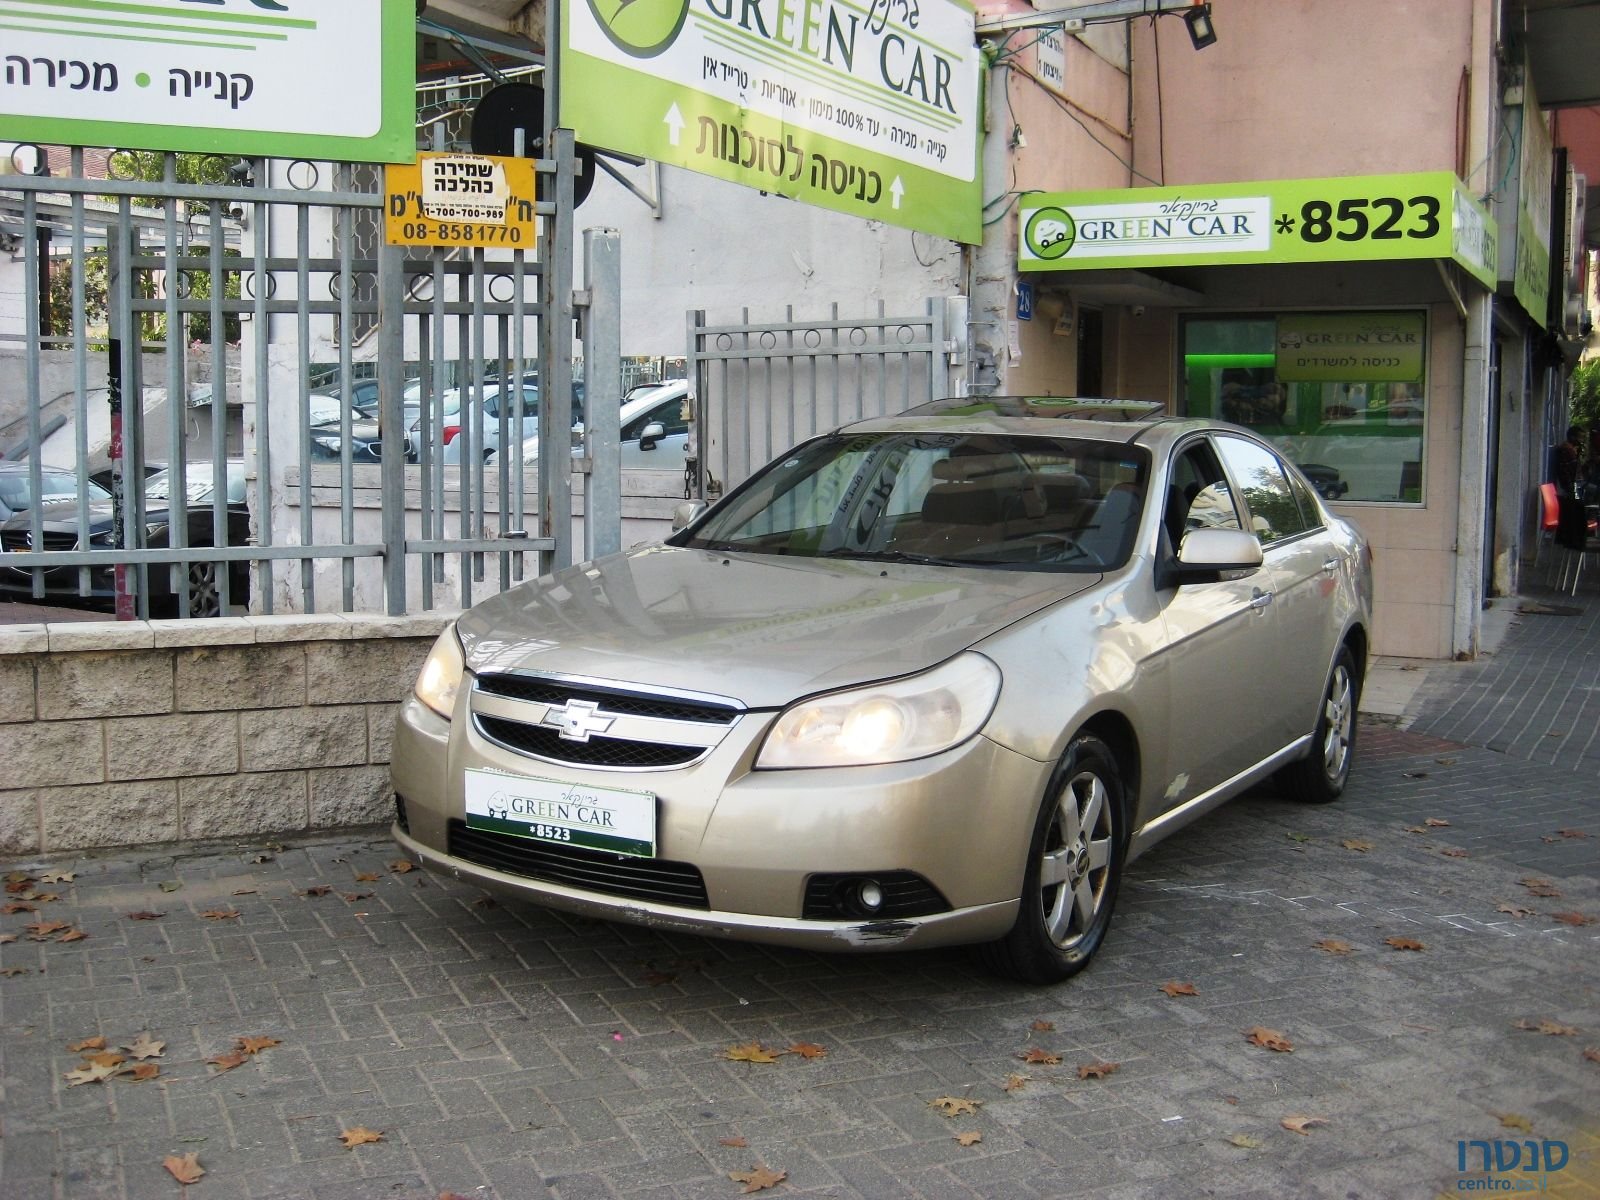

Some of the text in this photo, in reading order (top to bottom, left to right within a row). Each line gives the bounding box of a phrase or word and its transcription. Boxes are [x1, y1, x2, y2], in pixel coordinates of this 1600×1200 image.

[5, 55, 254, 110] קנייה מכירה
[880, 33, 957, 115] CAR
[702, 54, 948, 163] קנייה מכירה עד 100% מימון אחריות טרייד אין
[434, 162, 493, 178] שמירה
[695, 115, 882, 204] כניסה לסוכנות
[434, 177, 493, 194] כהלכה
[425, 207, 504, 219] 1-700-700-989
[403, 222, 521, 243] 08-8581770
[1080, 215, 1253, 241] GREEN CAR
[1019, 290, 1030, 312] 28
[1305, 332, 1417, 344] GREEN CAR
[1296, 356, 1401, 367] כניסה למשרדים
[511, 798, 613, 827] GREEN CAR
